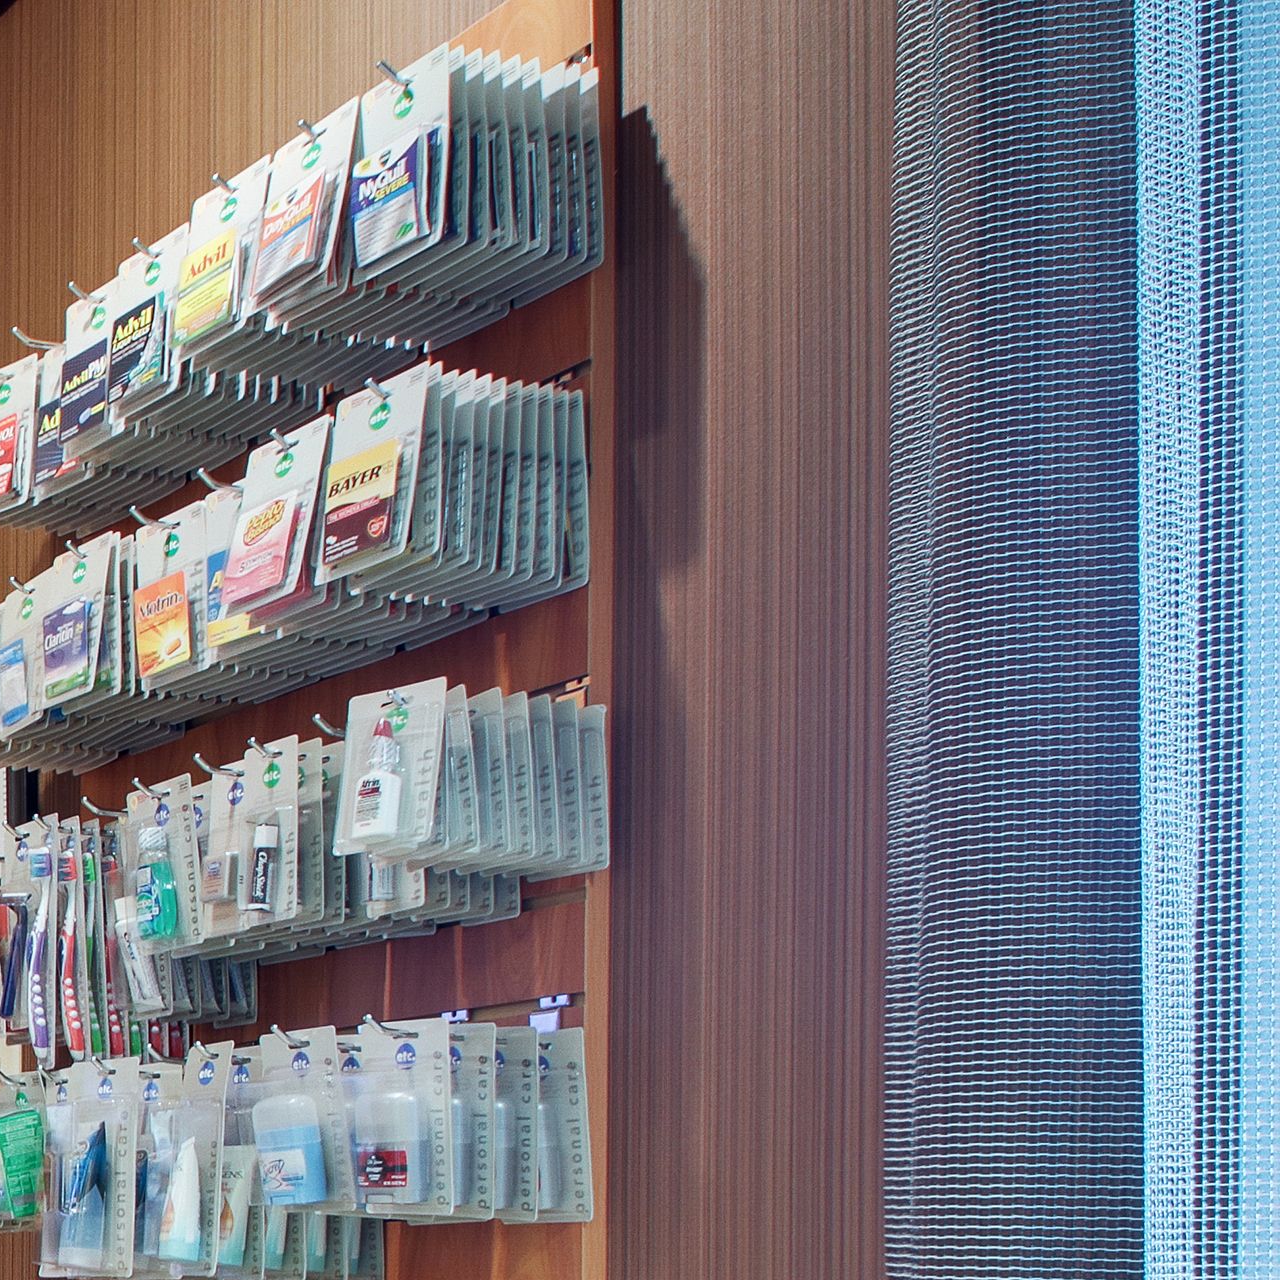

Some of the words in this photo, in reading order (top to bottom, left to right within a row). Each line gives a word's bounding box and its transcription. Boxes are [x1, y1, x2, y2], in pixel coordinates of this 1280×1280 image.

[185, 242, 227, 283] Advil
[113, 305, 154, 343] Advil
[62, 371, 88, 395] Advil
[328, 465, 382, 498] BAYER
[140, 592, 179, 617] Motrin
[181, 804, 193, 844] care
[184, 853, 201, 938] personal
[479, 1055, 488, 1101] care
[521, 1058, 532, 1103] care
[567, 1060, 578, 1106] care
[119, 1110, 130, 1158] care
[477, 1113, 487, 1209] personal
[517, 1116, 531, 1213] personal
[567, 1117, 585, 1213] personal
[115, 1165, 128, 1271] personal
